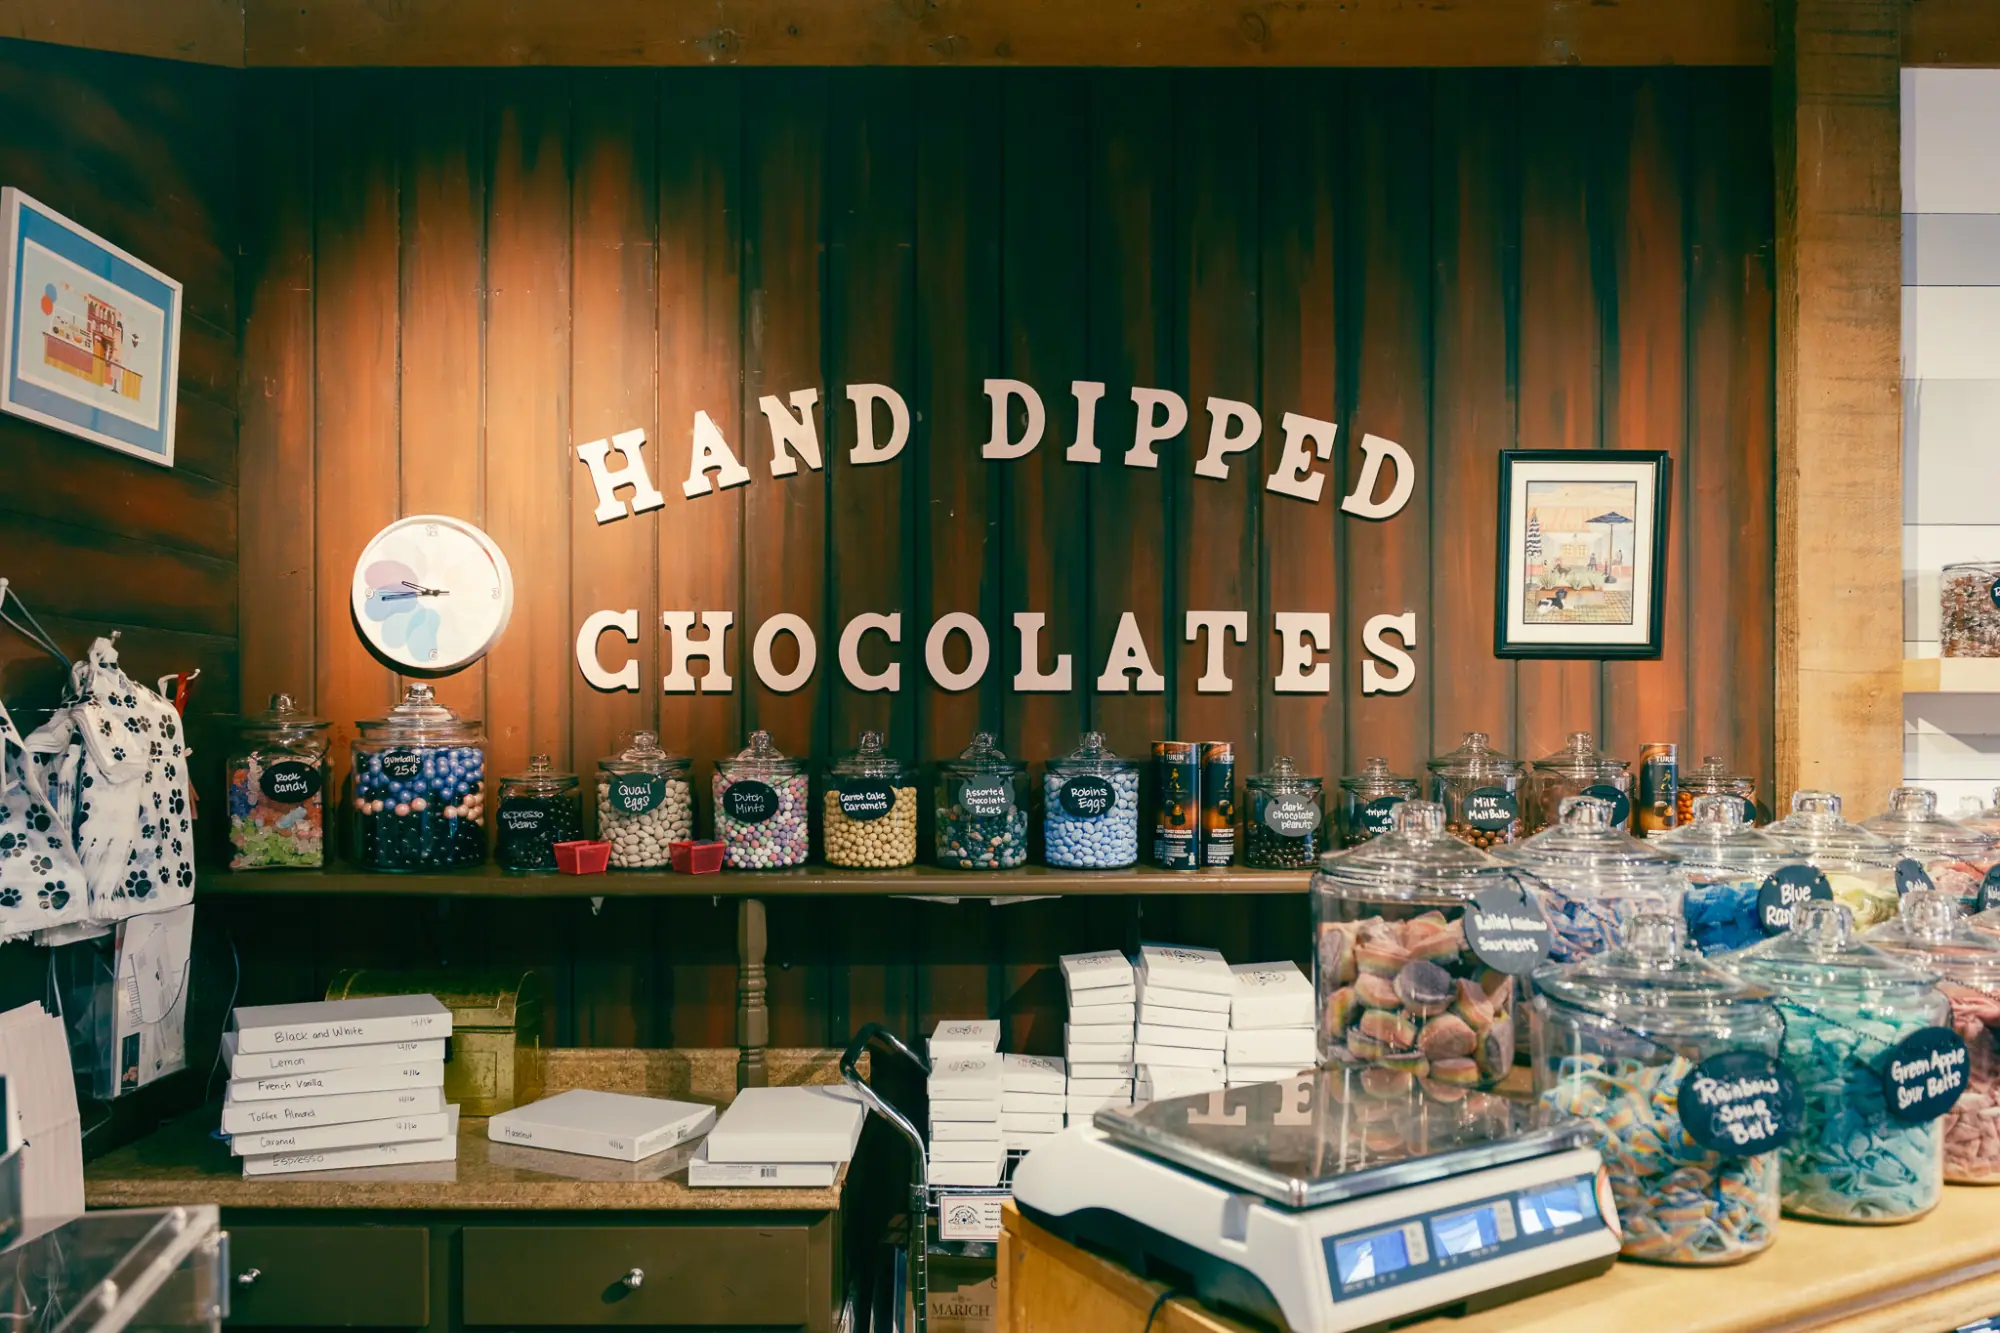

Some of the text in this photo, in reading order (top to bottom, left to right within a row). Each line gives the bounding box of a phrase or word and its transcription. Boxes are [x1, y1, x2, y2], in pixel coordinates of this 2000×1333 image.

[576, 378, 1415, 524] HAND DIPPED
[576, 610, 1416, 694] CHOCOLATES
[383, 754, 421, 767] gumballs
[394, 764, 418, 776] 25¢
[275, 772, 301, 782] Rock
[618, 782, 652, 796] Quail
[965, 787, 1005, 798] Assorted
[1070, 787, 1108, 798] Robins
[732, 792, 764, 803] Dutch
[840, 791, 887, 802] Carrot Cake
[735, 803, 765, 814] Mints
[843, 801, 888, 811] Caramels
[975, 805, 1001, 814] Rocks
[1078, 798, 1106, 814] Eggs
[1281, 801, 1304, 811] dark
[502, 810, 544, 823] espresso
[1272, 810, 1314, 820] chocolate
[508, 820, 538, 830] beans
[1281, 820, 1313, 830] peanuts
[1780, 883, 1811, 905] Blue
[273, 1030, 308, 1043] Black
[312, 1028, 330, 1039] and
[332, 1026, 364, 1037] White
[270, 1057, 305, 1069] Lemon
[1891, 1047, 1965, 1084] Green Apple
[257, 1080, 291, 1091] French
[296, 1078, 324, 1088] Vanilla
[1897, 1071, 1961, 1110] Sour Belts
[1692, 1077, 1780, 1106] Rainbow
[248, 1112, 278, 1122] Toffee
[284, 1108, 316, 1119] Almond
[260, 1137, 296, 1147] Caramel
[272, 1154, 324, 1167] Espresso
[931, 1303, 991, 1316] MARICH
